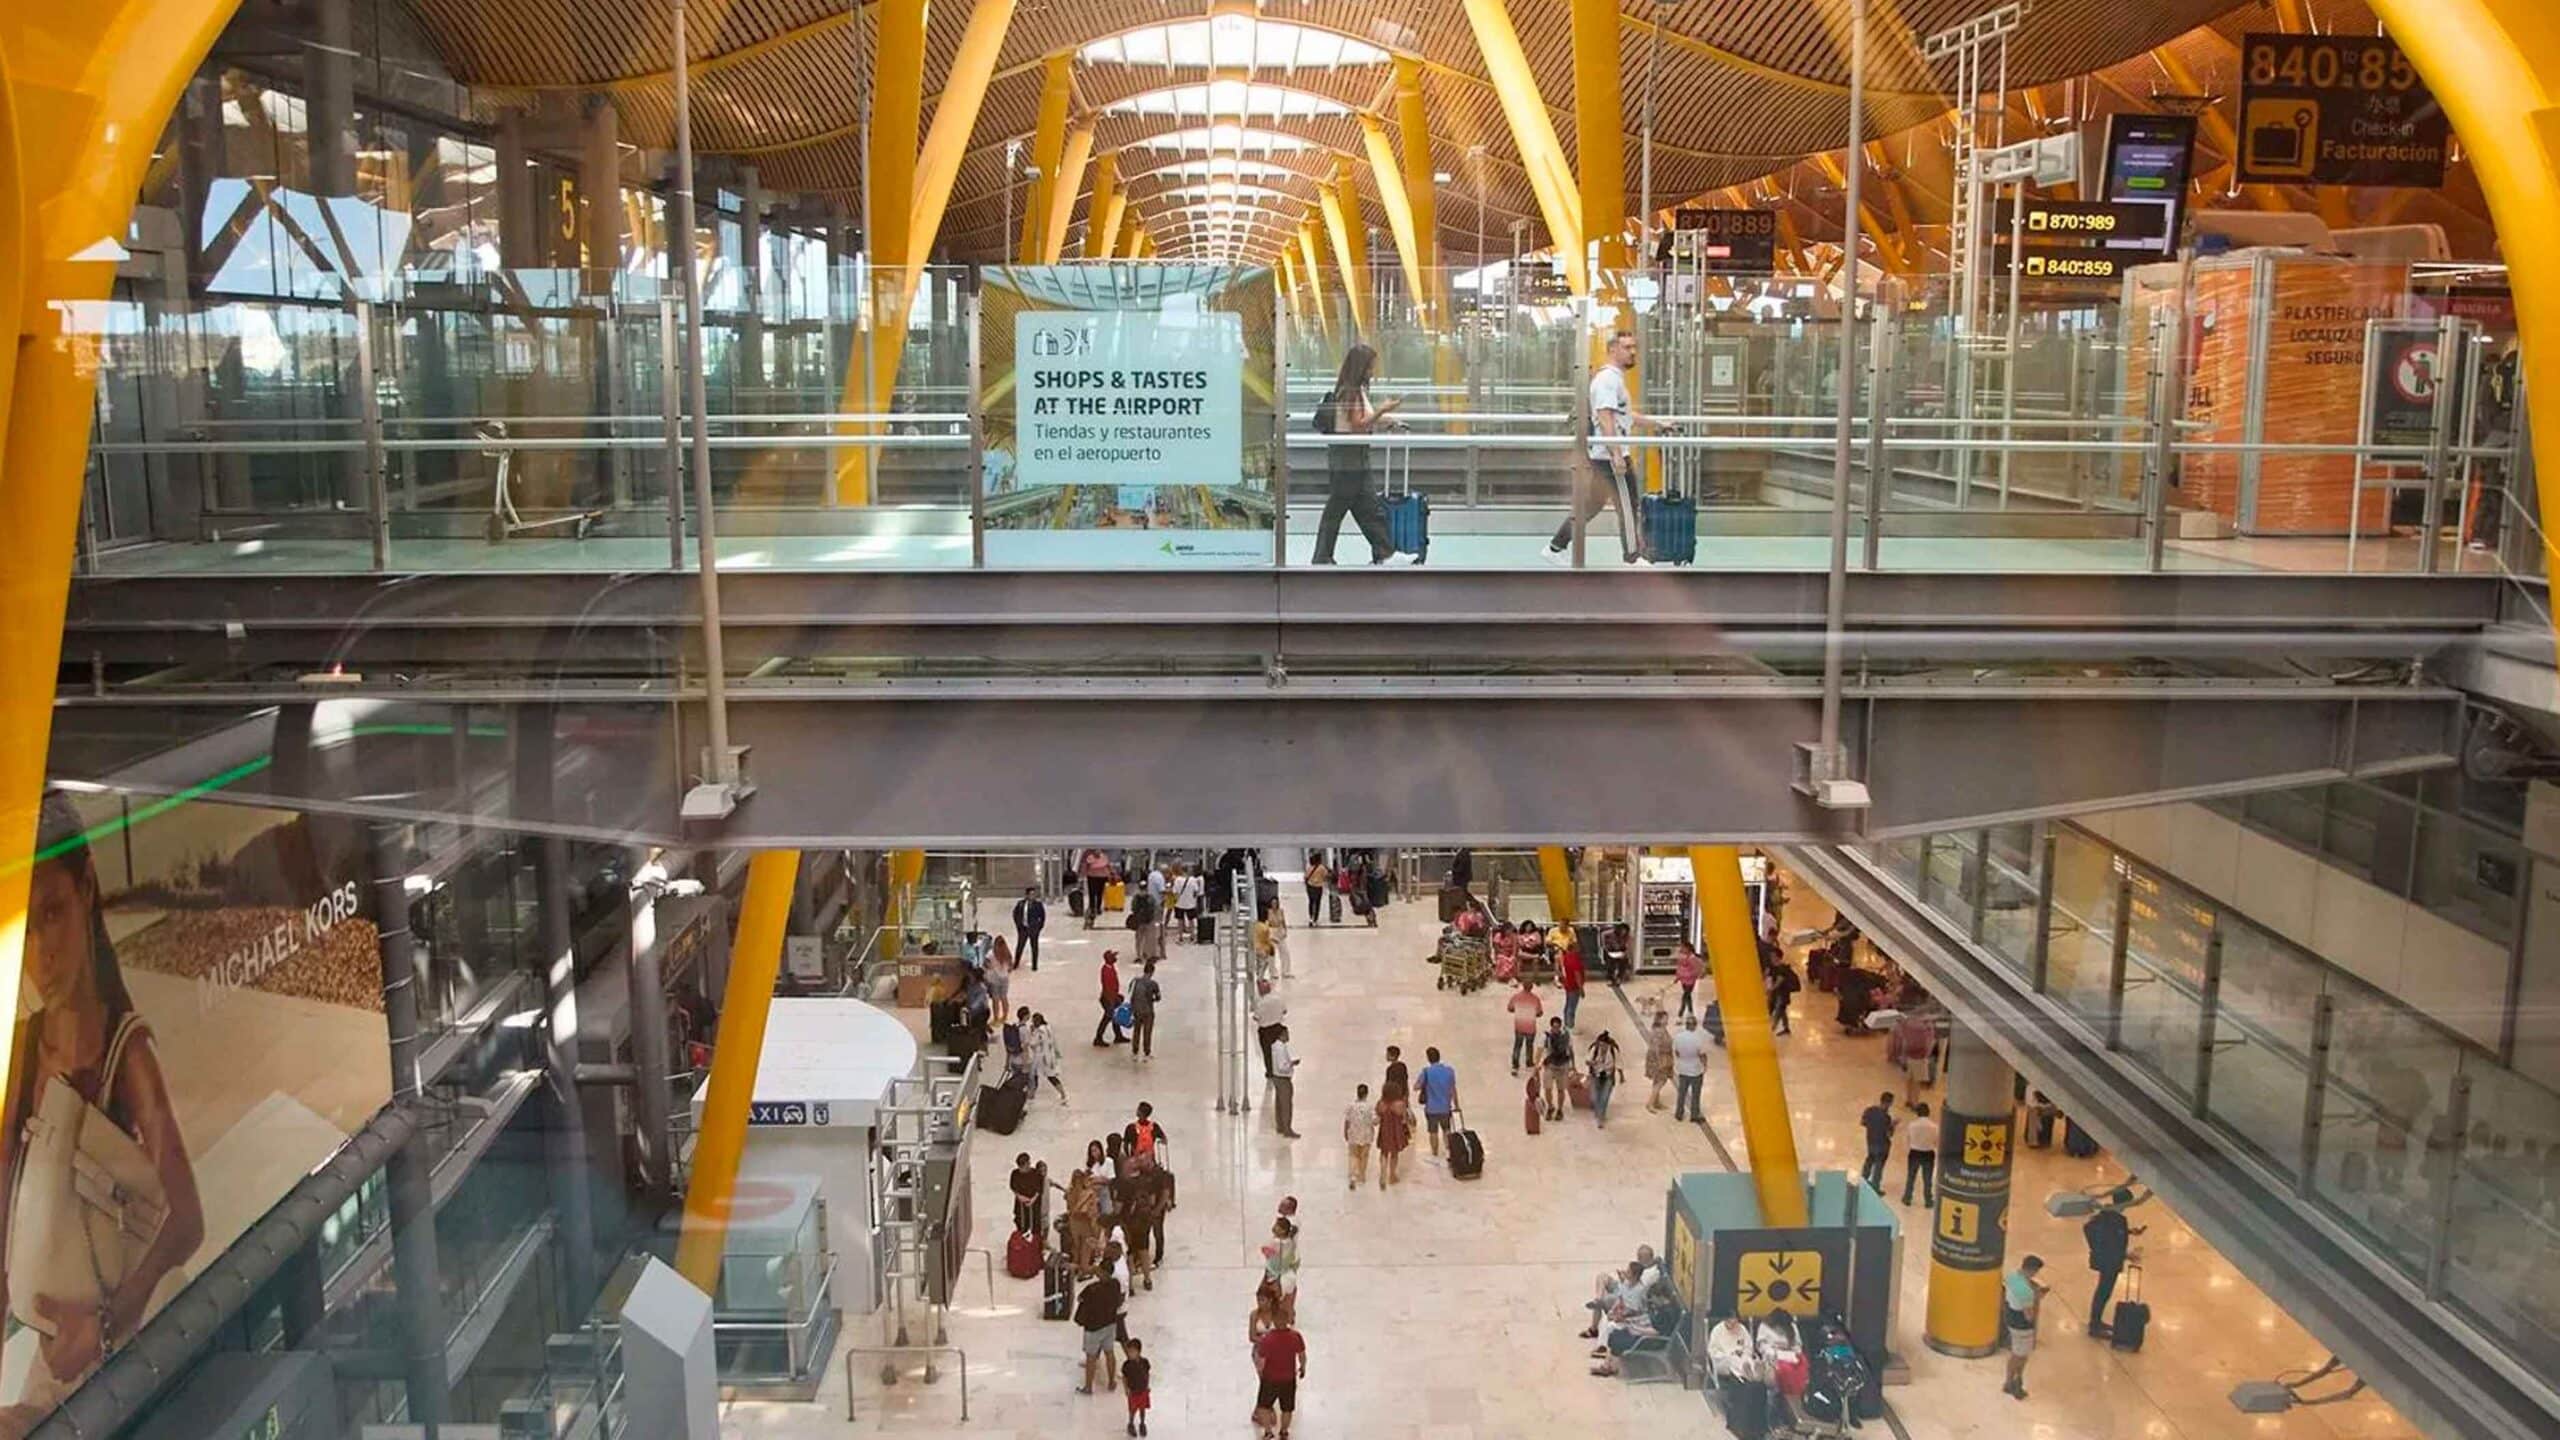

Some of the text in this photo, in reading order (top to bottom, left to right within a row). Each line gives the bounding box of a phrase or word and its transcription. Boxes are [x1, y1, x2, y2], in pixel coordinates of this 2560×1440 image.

[2251, 45, 2339, 88] 840
[2360, 50, 2416, 91] 85
[2352, 118, 2415, 136] Check-in
[2322, 138, 2439, 161] Facturación
[562, 179, 575, 241] 5
[1730, 214, 1771, 234] 889
[2289, 328, 2366, 342] LOCALIZAD
[1034, 371, 1208, 389] SHOPS & TASTES
[1034, 397, 1205, 415] AT THE AIRPORT
[1035, 423, 1211, 442] Tiendas y restaurantes
[1034, 446, 1162, 464] en el aeropuerto
[196, 880, 358, 1005] MICHAEL KORS
